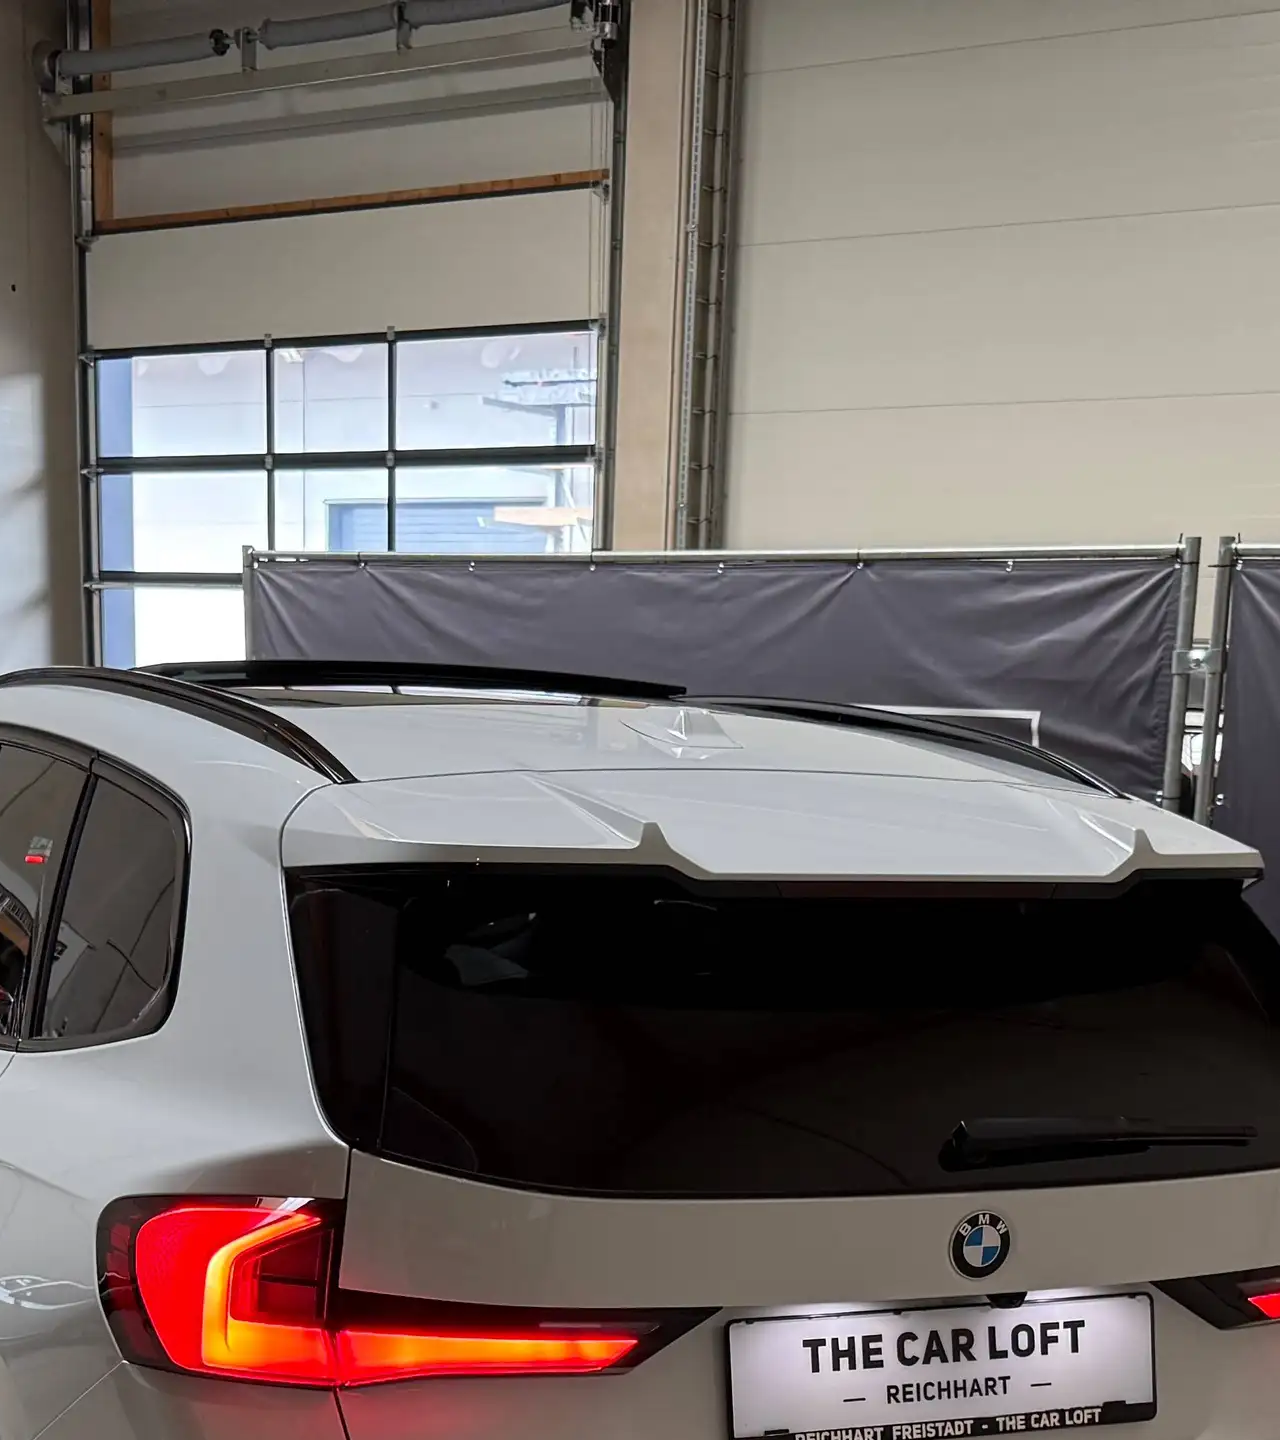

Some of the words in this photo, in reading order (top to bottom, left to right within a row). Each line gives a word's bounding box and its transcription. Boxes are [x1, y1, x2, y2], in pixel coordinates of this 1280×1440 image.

[959, 1213, 1008, 1237] BMW
[802, 1333, 885, 1374] THE
[896, 1327, 977, 1367] CAR
[987, 1319, 1087, 1361] LOFT
[886, 1375, 1011, 1405] REICHHART
[892, 1419, 974, 1440] FREISTADT
[995, 1415, 1026, 1432] THE
[1031, 1412, 1061, 1428] CAR
[1065, 1407, 1102, 1425] LOFT
